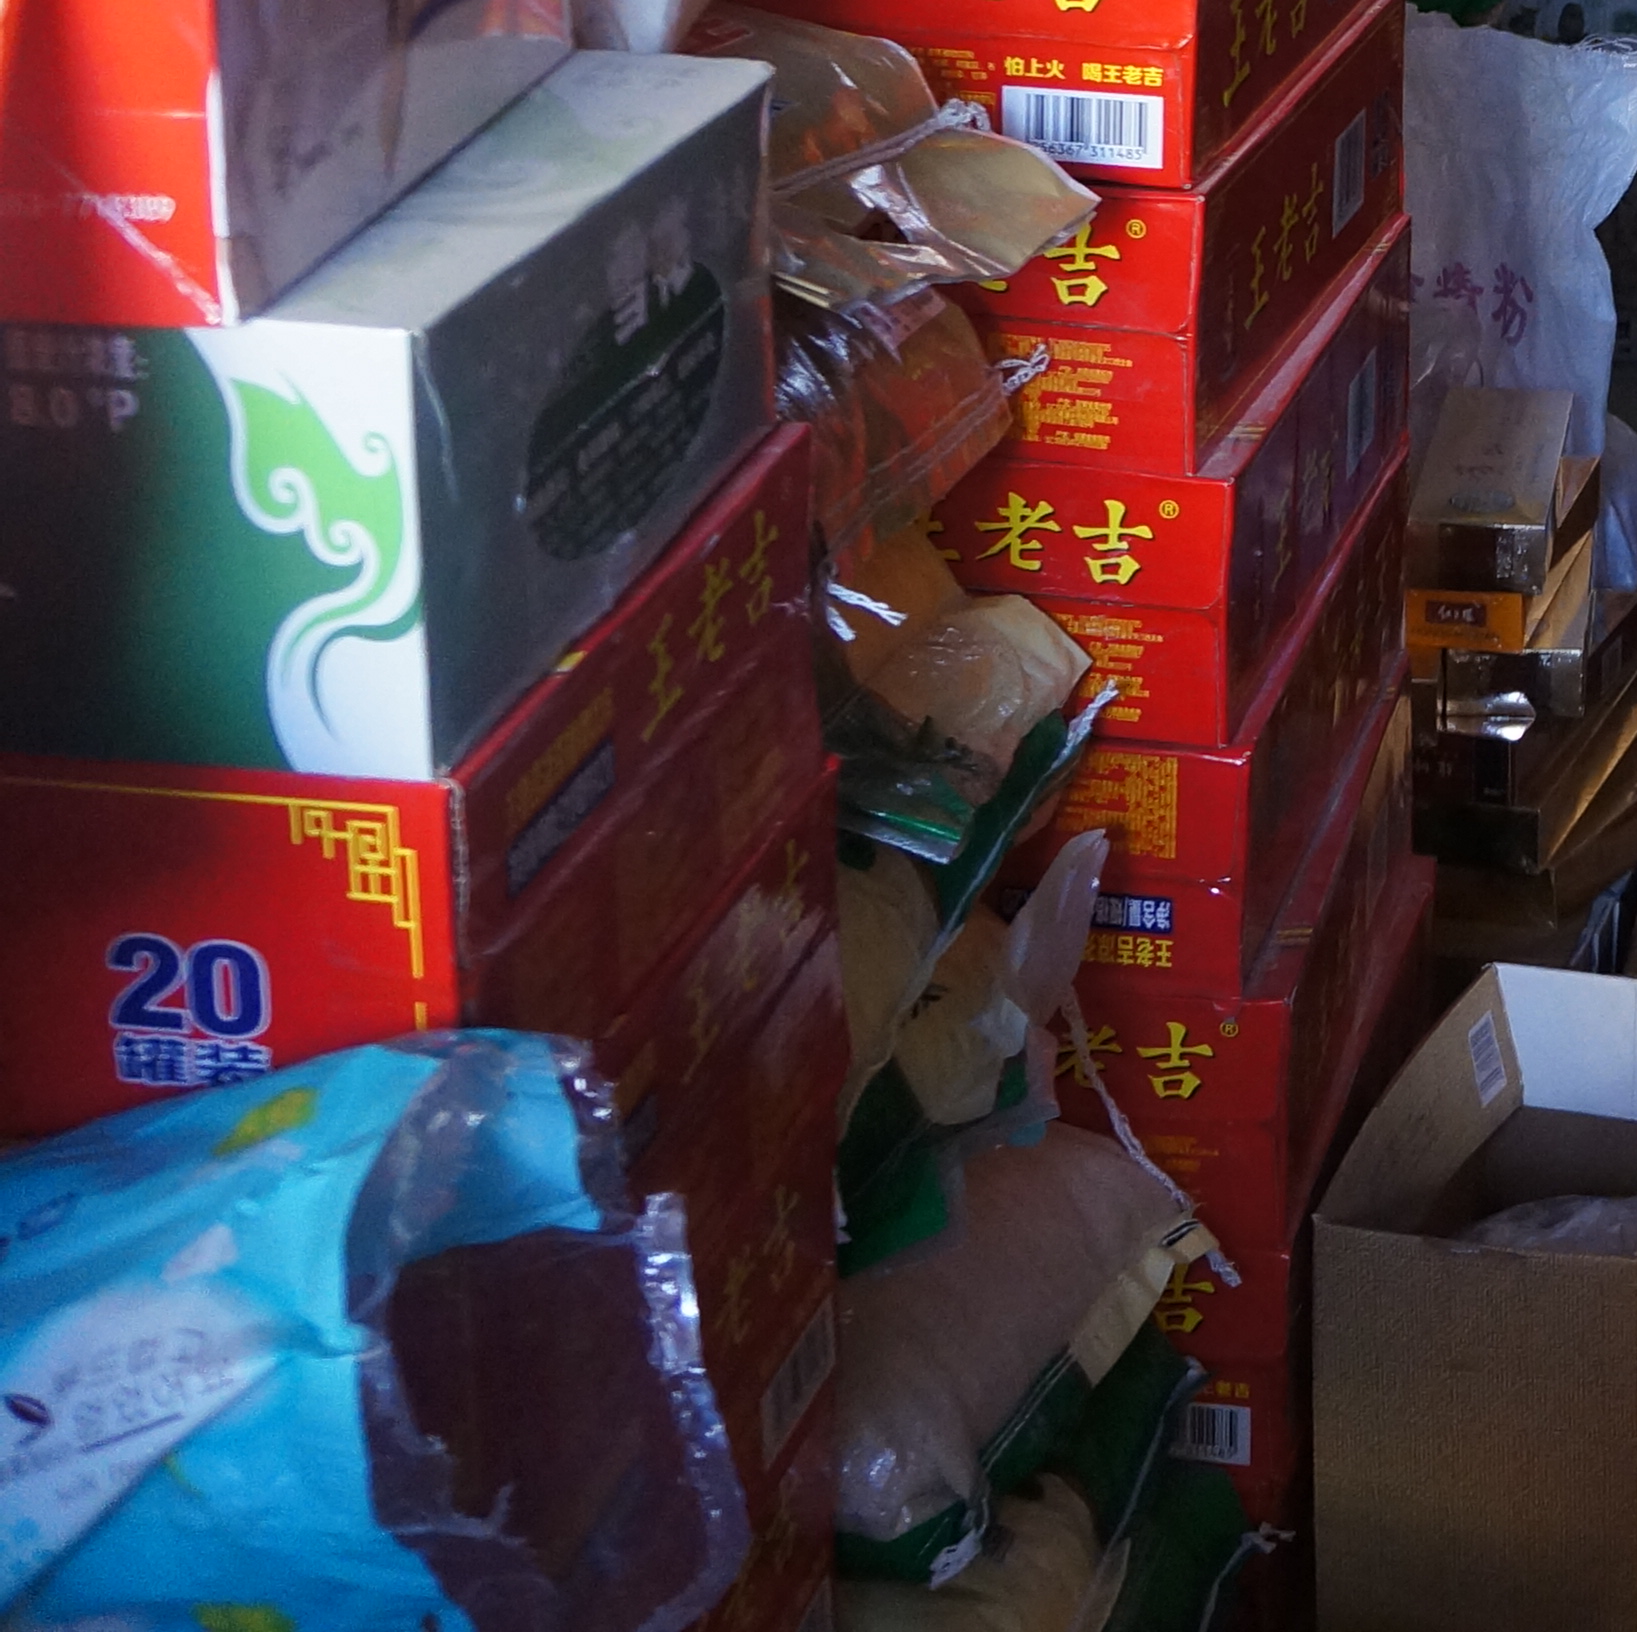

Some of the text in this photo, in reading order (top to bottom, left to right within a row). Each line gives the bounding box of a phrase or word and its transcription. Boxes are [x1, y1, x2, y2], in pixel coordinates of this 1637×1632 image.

[1003, 56, 1164, 87] 怕上火 喝王老吉
[107, 933, 271, 1037] 20
